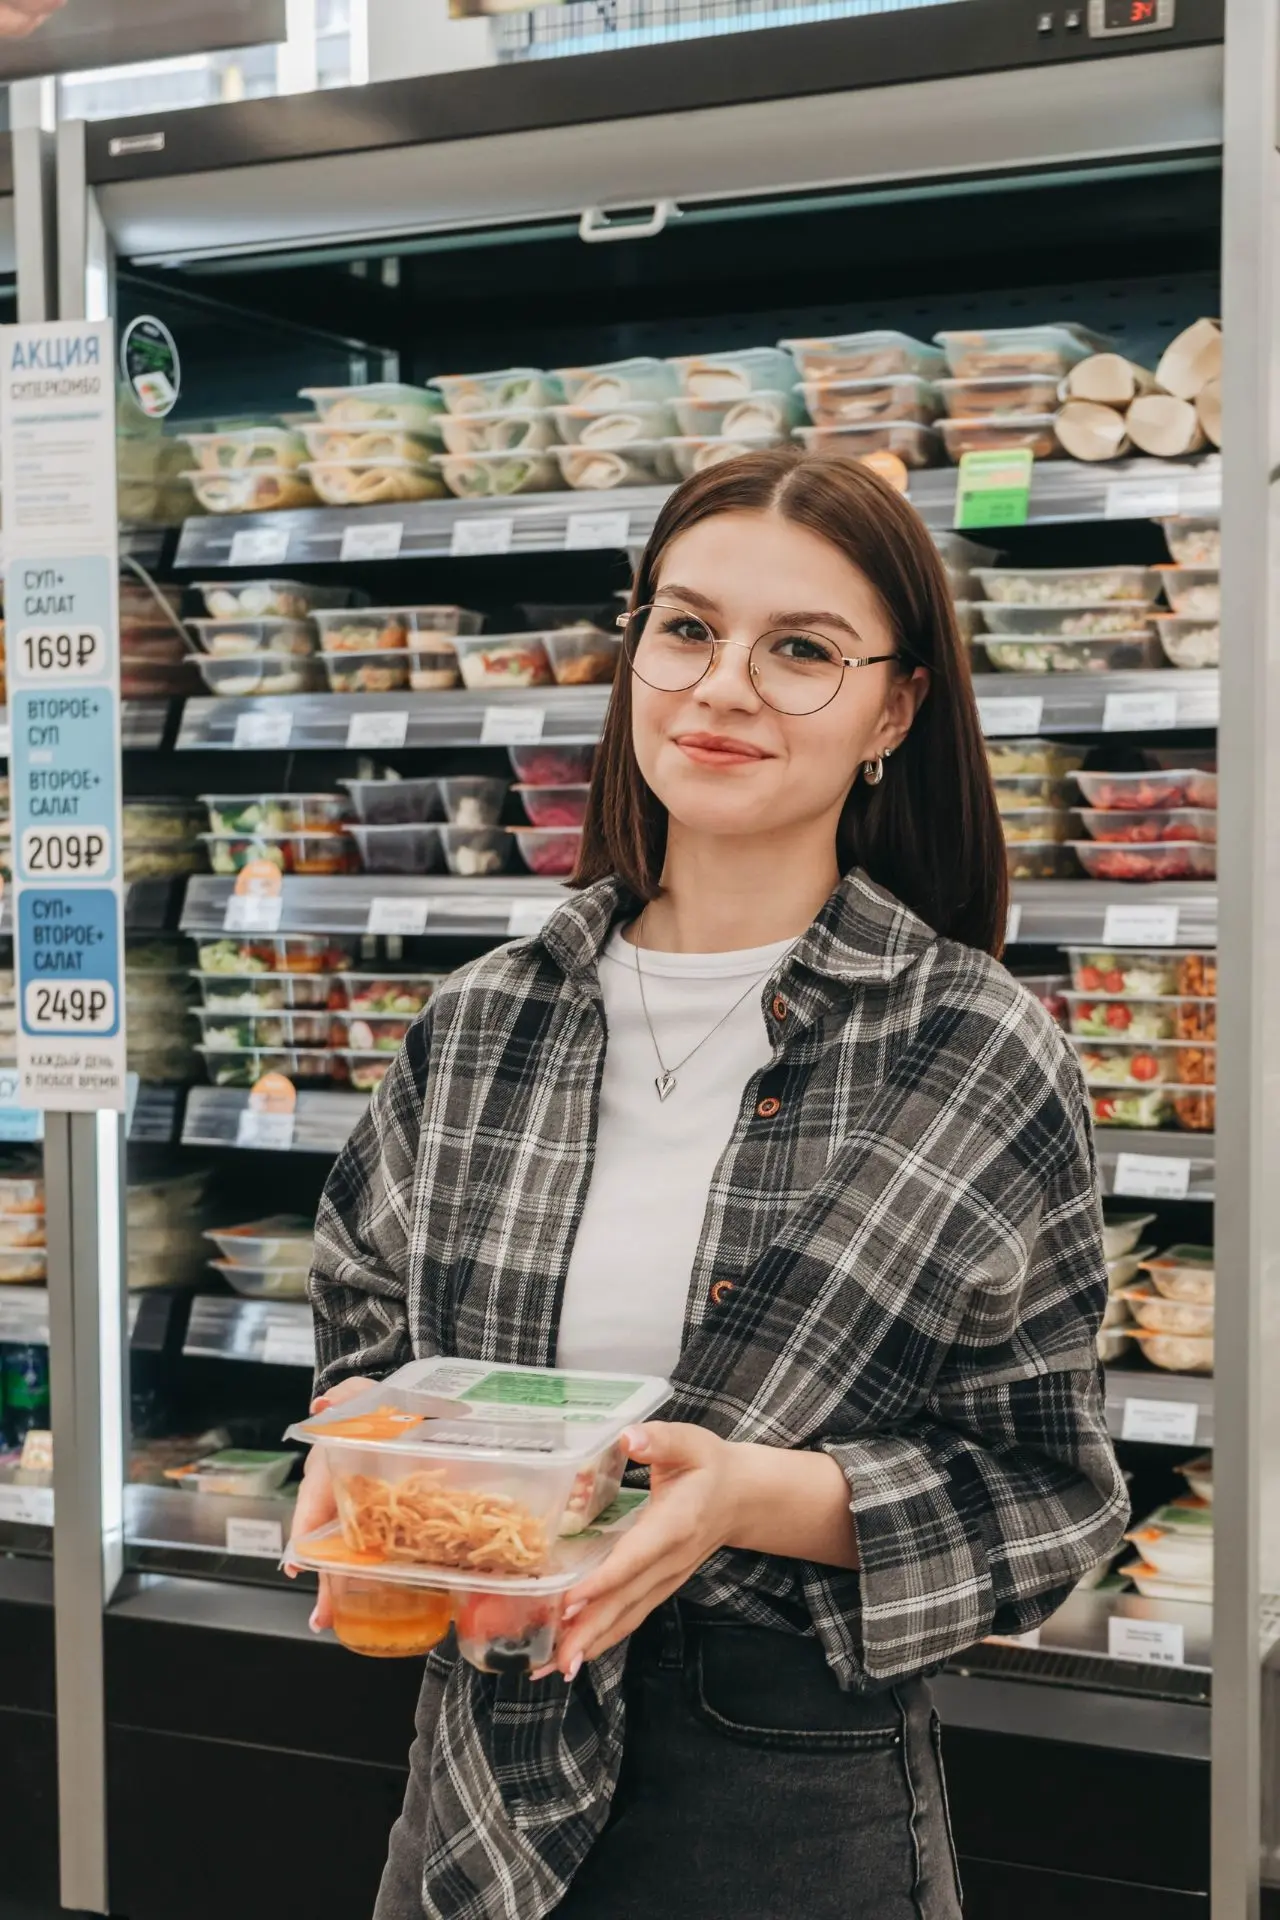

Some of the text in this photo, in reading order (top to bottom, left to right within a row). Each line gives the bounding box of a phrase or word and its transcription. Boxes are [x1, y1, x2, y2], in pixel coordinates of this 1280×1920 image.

[11, 336, 99, 372] АКЦИЯ
[24, 570, 64, 590] СУП+
[24, 595, 74, 616] САЛАТ
[27, 698, 99, 720] ВТОРОЕ+
[28, 726, 59, 745] СУП
[29, 769, 101, 792] ВТОРОЕ+
[29, 796, 80, 817] САЛАТ
[32, 899, 73, 921] СУП+
[33, 925, 105, 946] ВТОРОЕ+
[33, 951, 84, 972] САЛАТ
